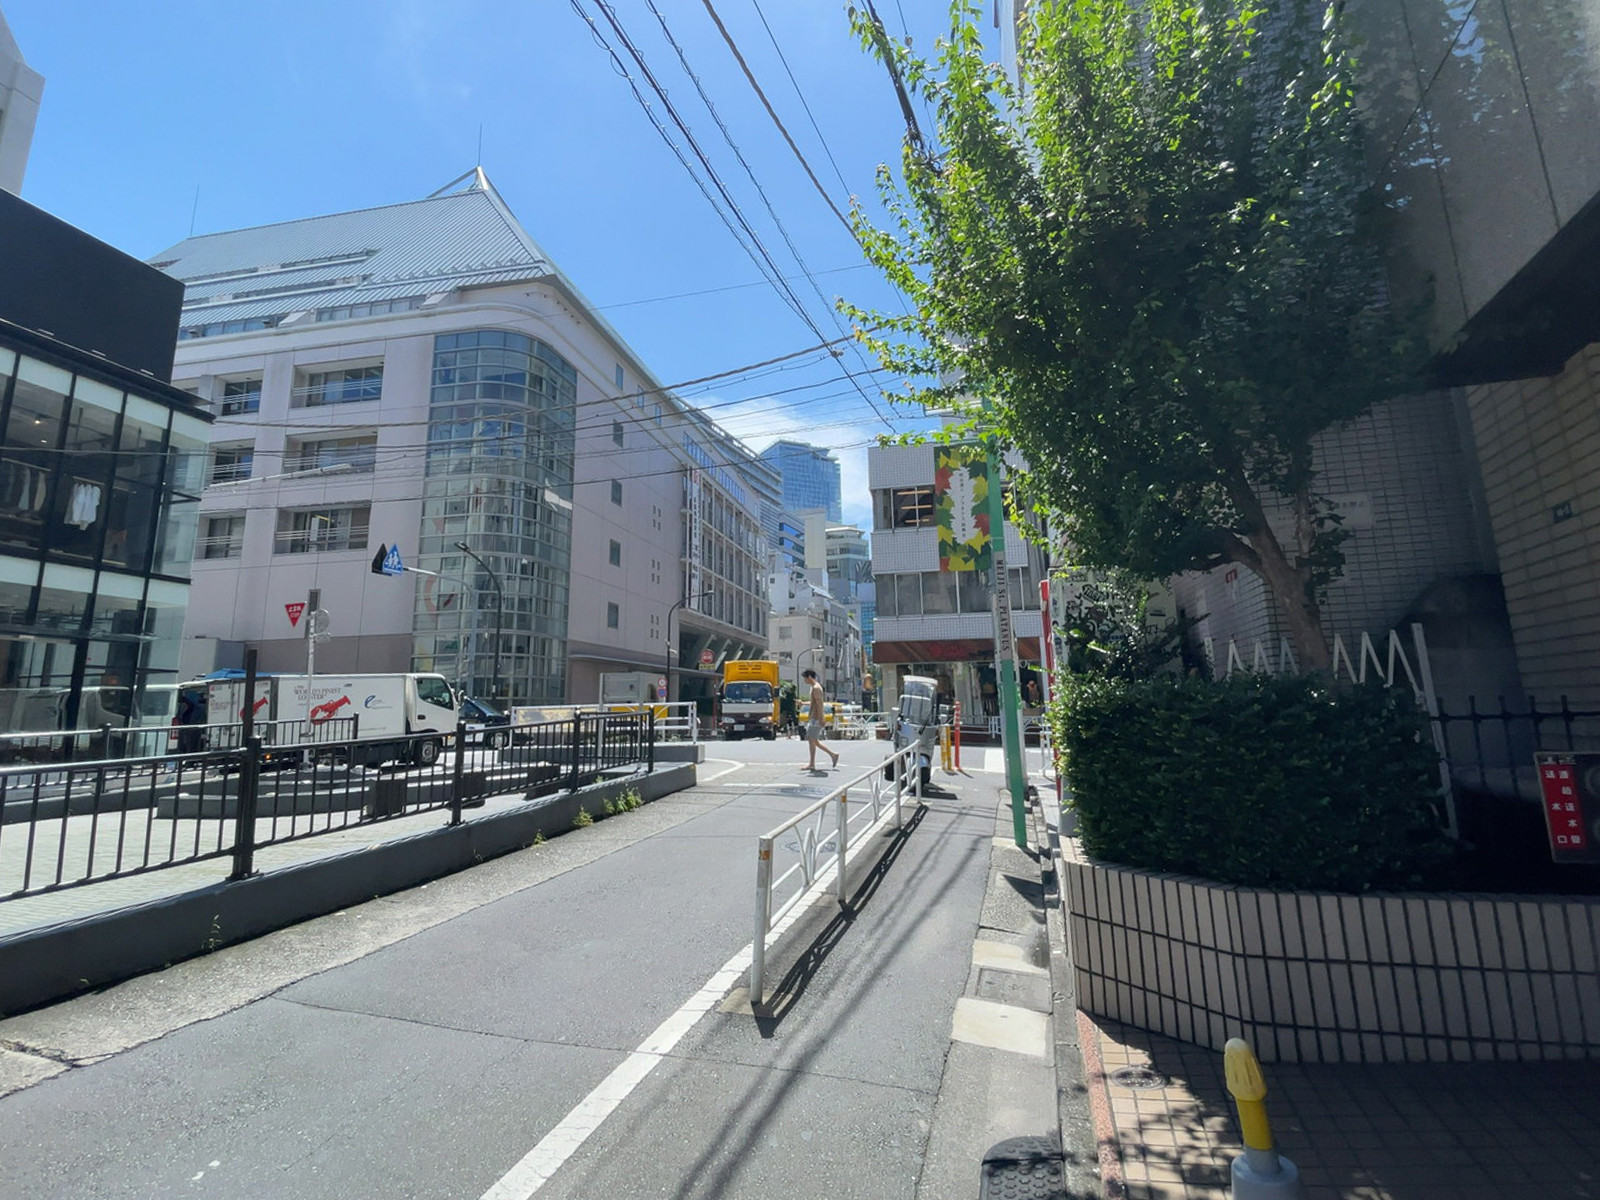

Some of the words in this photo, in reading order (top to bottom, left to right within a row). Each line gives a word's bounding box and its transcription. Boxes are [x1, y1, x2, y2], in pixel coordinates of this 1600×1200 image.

[996, 559, 1006, 585] MEIJI
[999, 606, 1010, 652] PLATANUS
[1545, 770, 1567, 843] 送水口
